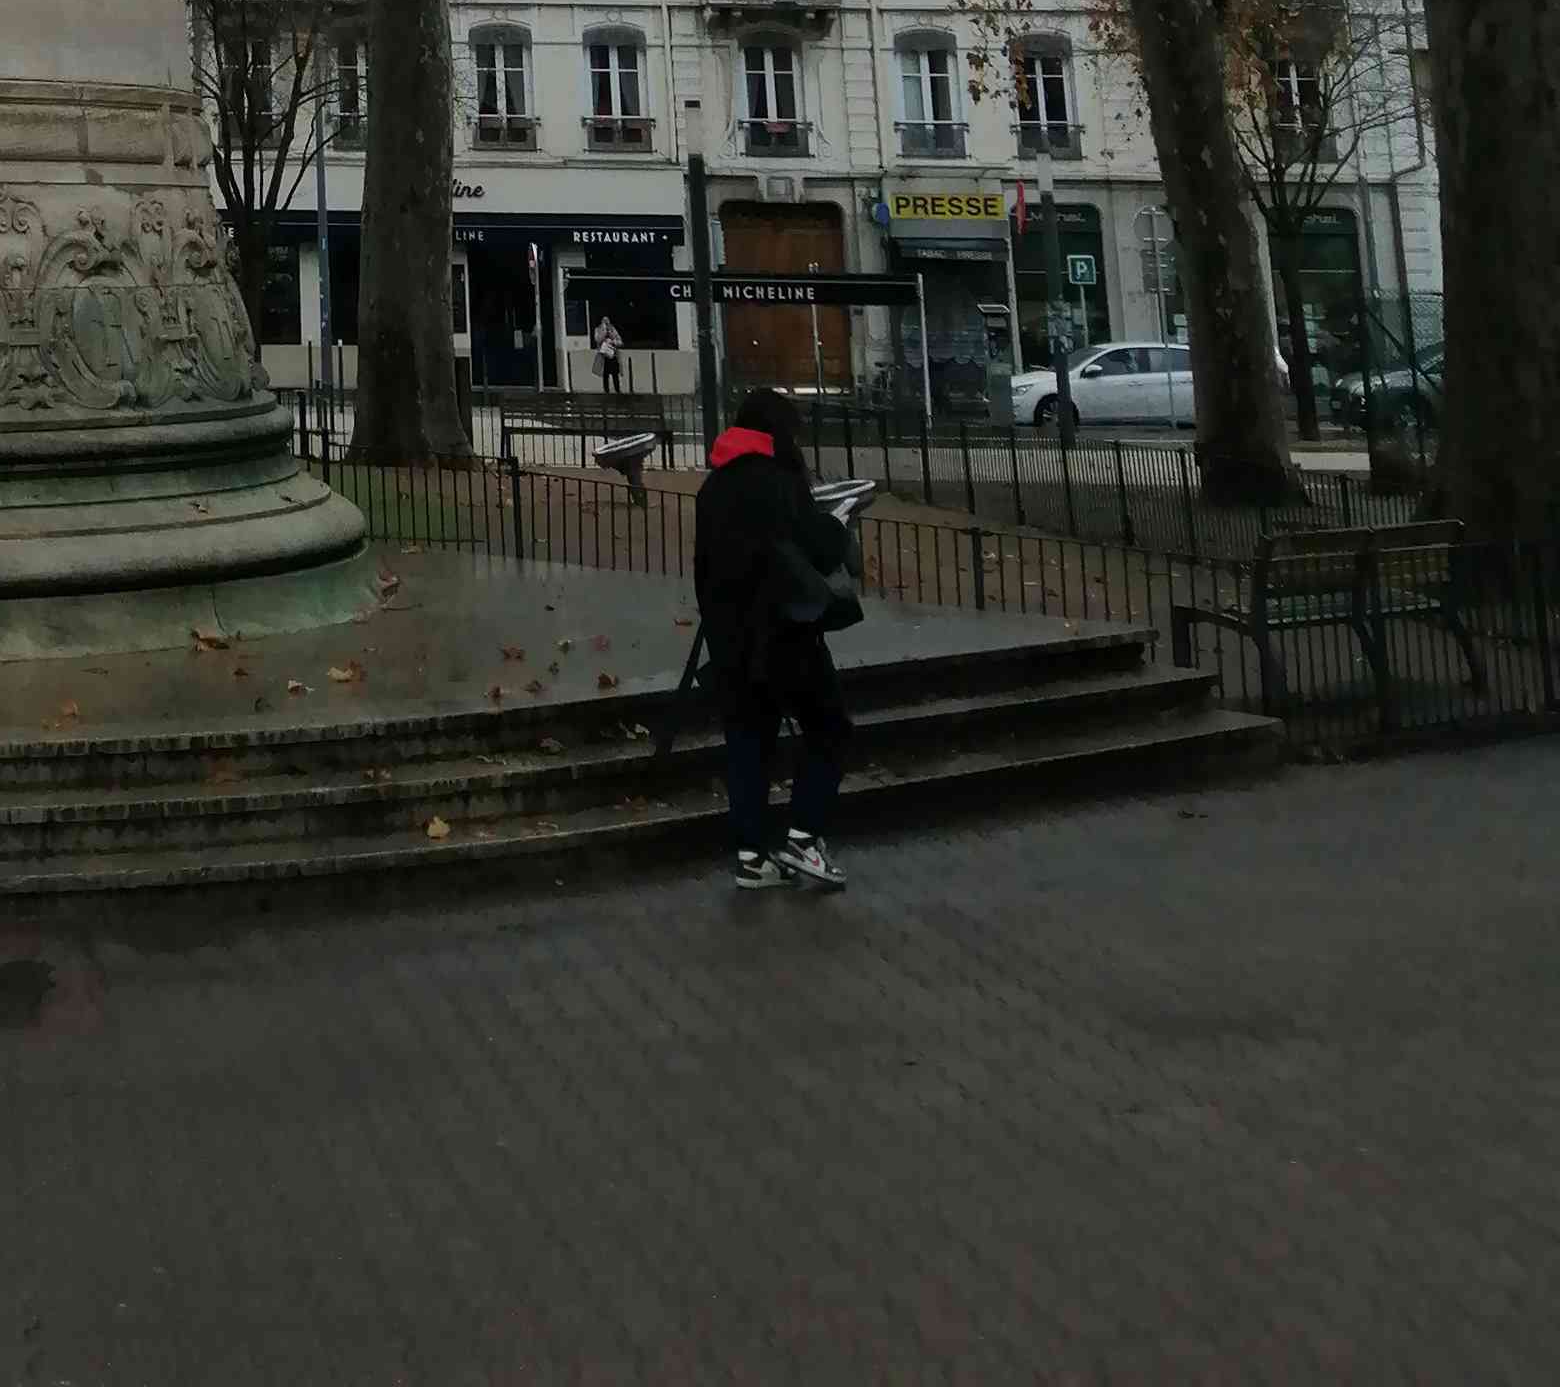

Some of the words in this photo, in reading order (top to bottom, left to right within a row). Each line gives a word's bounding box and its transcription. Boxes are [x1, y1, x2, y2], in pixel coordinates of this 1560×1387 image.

[895, 196, 998, 217] PRESSE
[573, 231, 656, 243] RESTAURANT
[1075, 261, 1089, 277] P
[723, 286, 816, 301] MICHELINE
